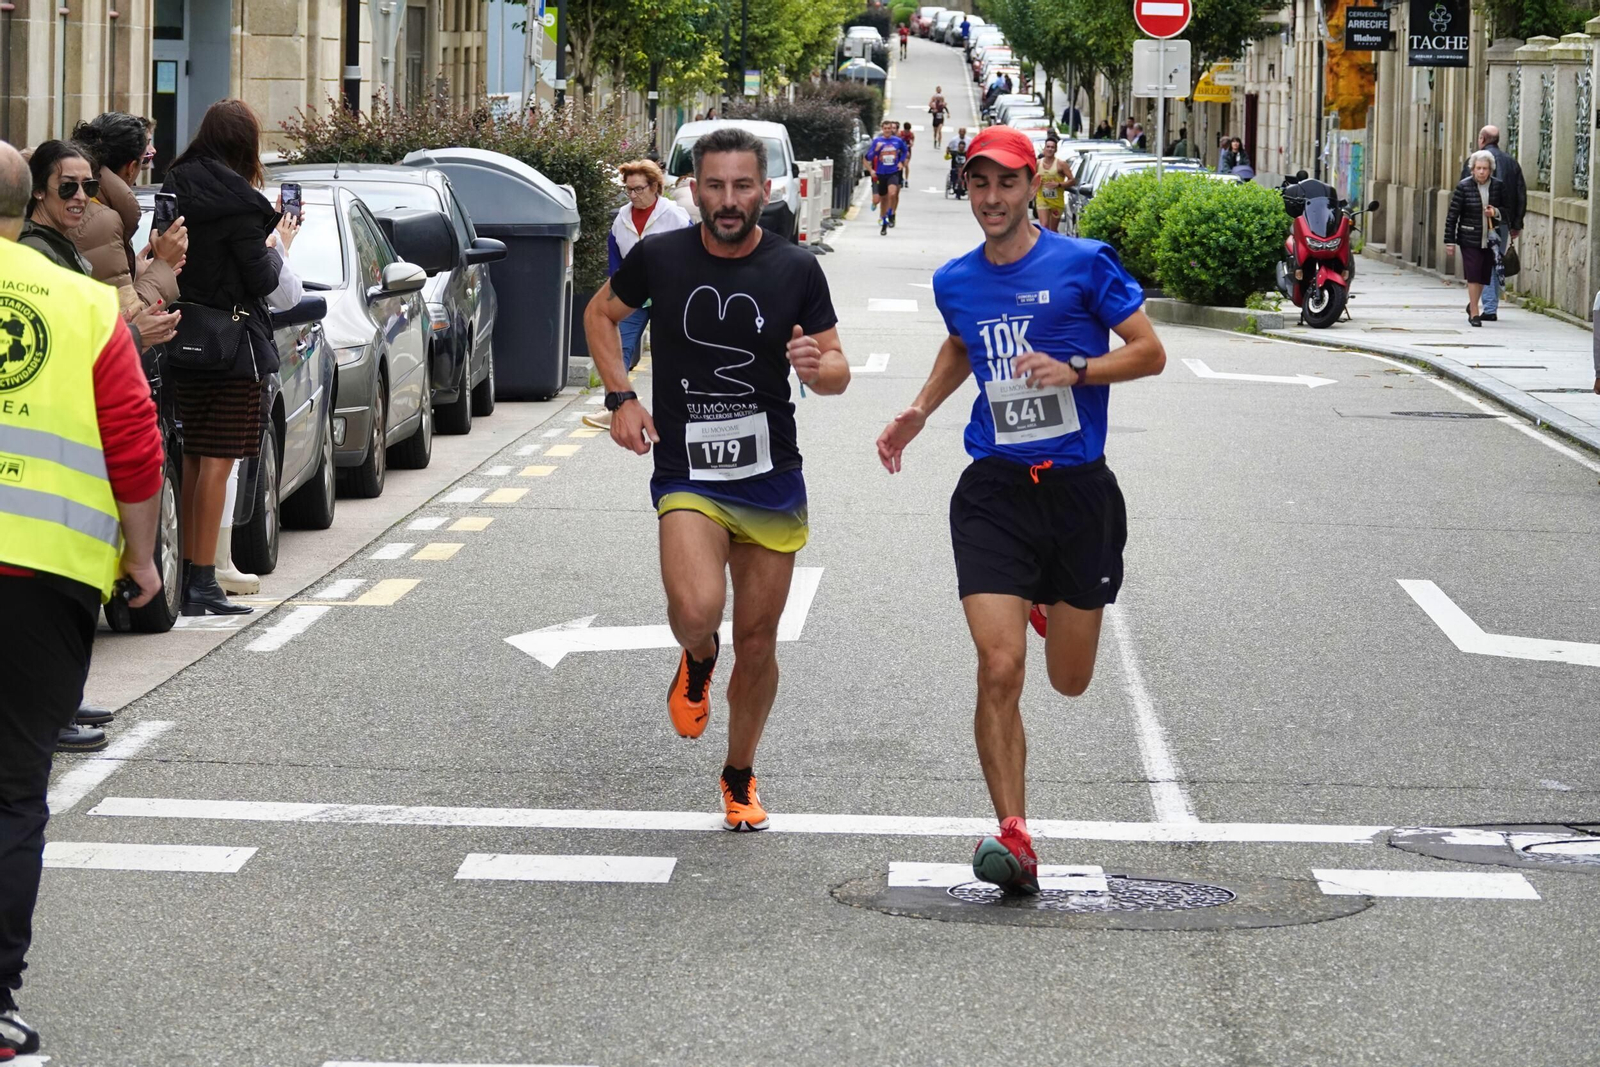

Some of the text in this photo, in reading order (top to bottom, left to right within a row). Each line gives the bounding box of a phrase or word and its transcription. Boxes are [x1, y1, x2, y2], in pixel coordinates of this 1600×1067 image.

[1347, 19, 1388, 29] ARRECIFE
[1353, 34, 1382, 42] Mahou
[1409, 35, 1469, 50] TACHE
[0, 280, 50, 297] IACIÓN
[979, 320, 1035, 360] 10K
[687, 402, 758, 414] EU MÓVOME
[1005, 398, 1046, 426] 641
[702, 412, 733, 420] ESCLEROSE
[701, 427, 709, 435] EU
[701, 439, 741, 464] 179
